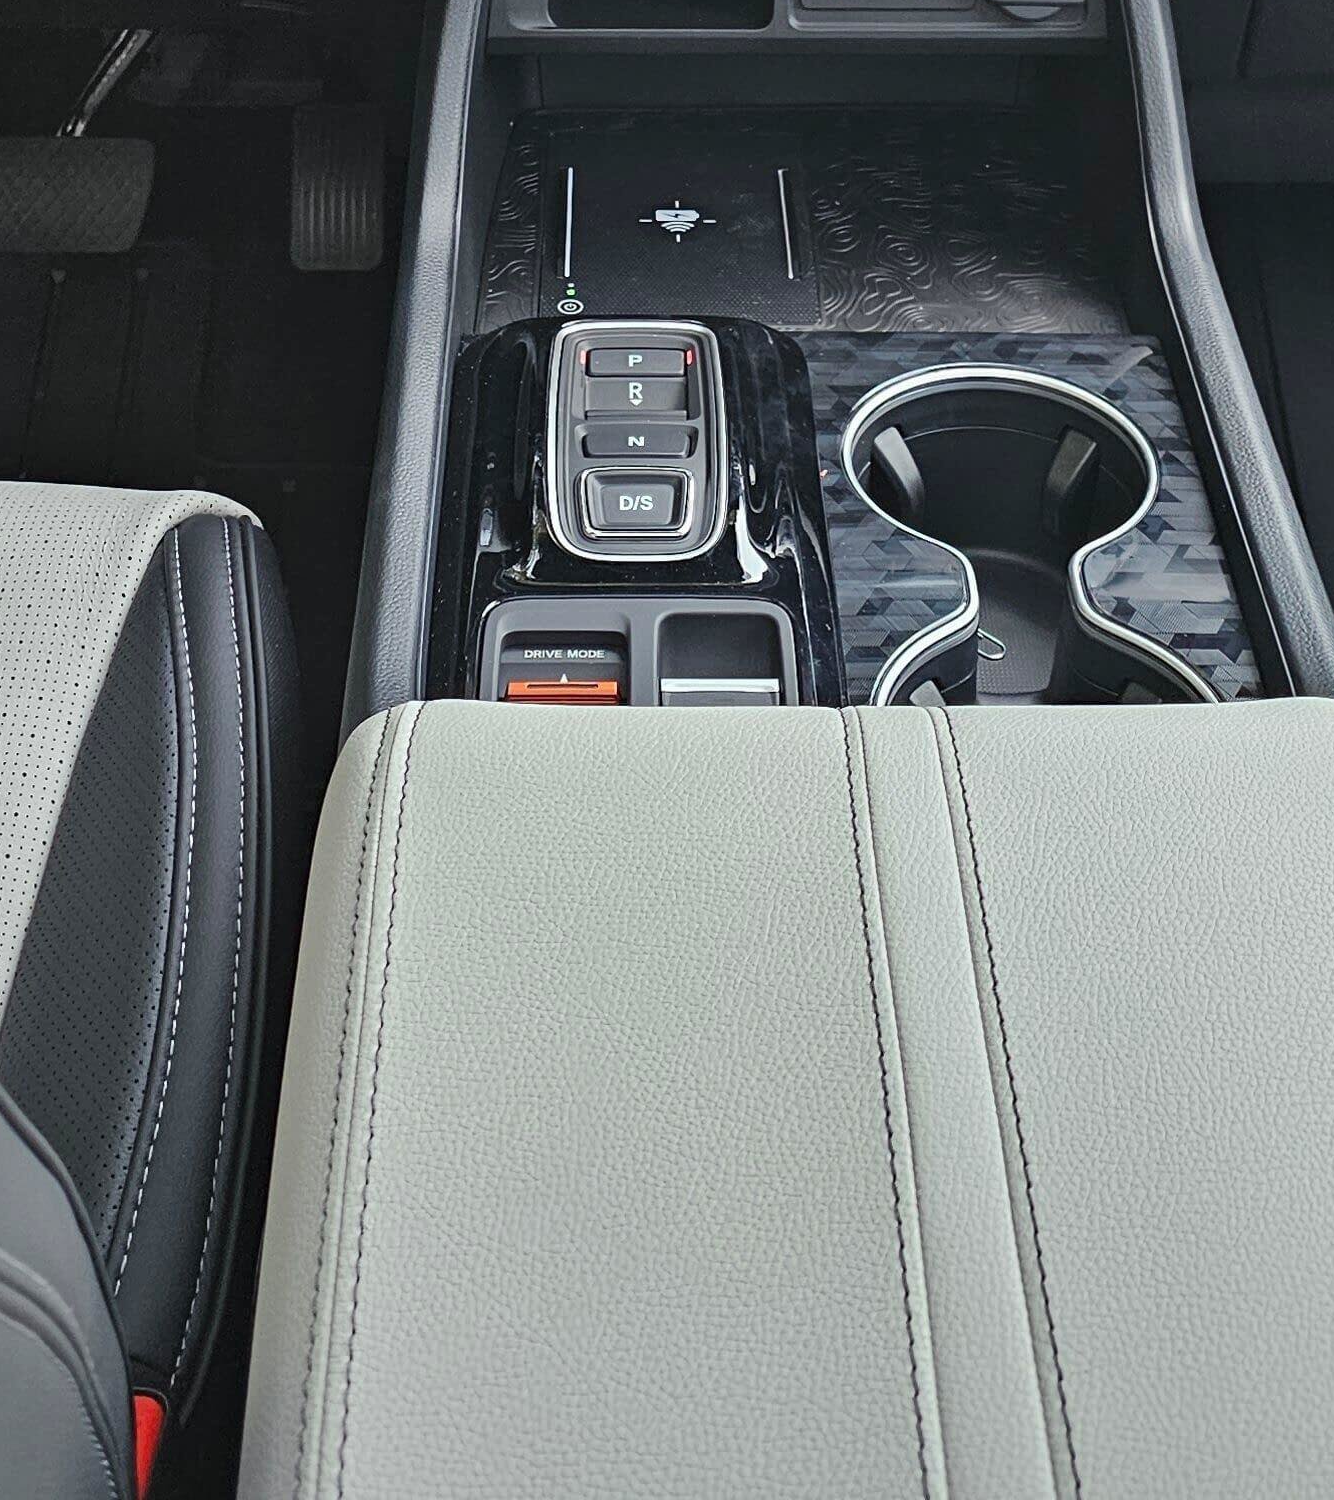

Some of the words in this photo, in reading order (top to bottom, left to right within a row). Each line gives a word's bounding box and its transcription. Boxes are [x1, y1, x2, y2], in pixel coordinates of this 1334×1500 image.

[628, 354, 643, 367] P
[628, 382, 643, 399] R
[627, 436, 645, 447] N
[619, 495, 654, 511] D/S
[524, 650, 563, 659] DRIVE
[567, 650, 605, 659] MODE
